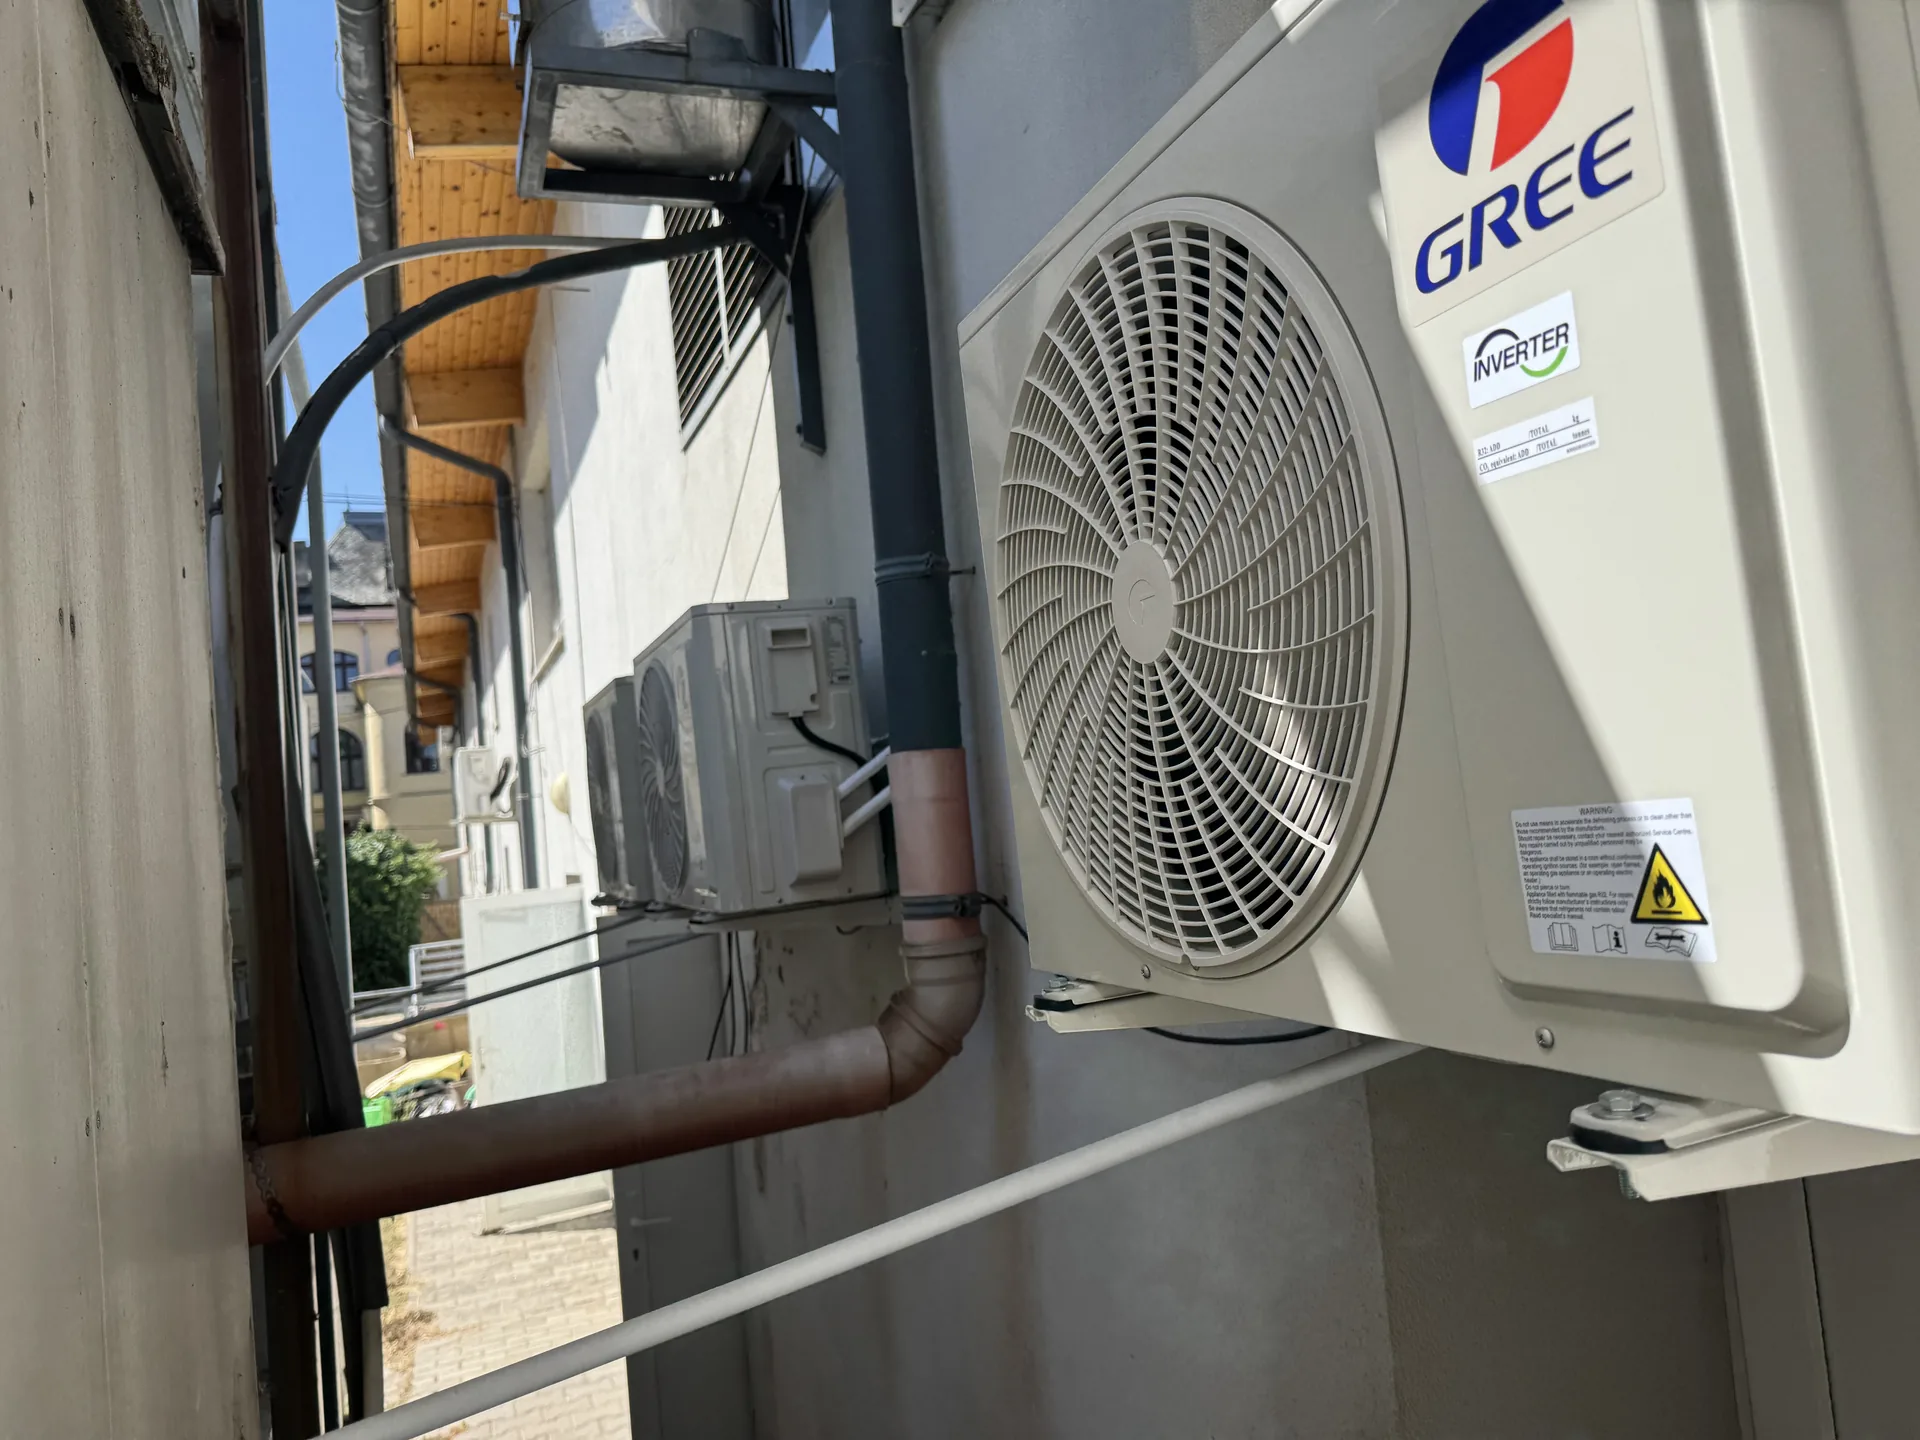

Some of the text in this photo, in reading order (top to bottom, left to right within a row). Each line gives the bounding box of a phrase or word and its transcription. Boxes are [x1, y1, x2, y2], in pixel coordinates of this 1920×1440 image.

[1415, 106, 1634, 294] GREE
[1473, 322, 1569, 382] INVERTER
[1477, 414, 1580, 457] R32: ADD /TOTAL kg
[1490, 453, 1517, 470] equivalent:
[1517, 448, 1530, 459] ADD
[1536, 438, 1557, 453] /TOTAL
[1572, 428, 1590, 440] tonnes
[1579, 806, 1613, 815] WARNING
